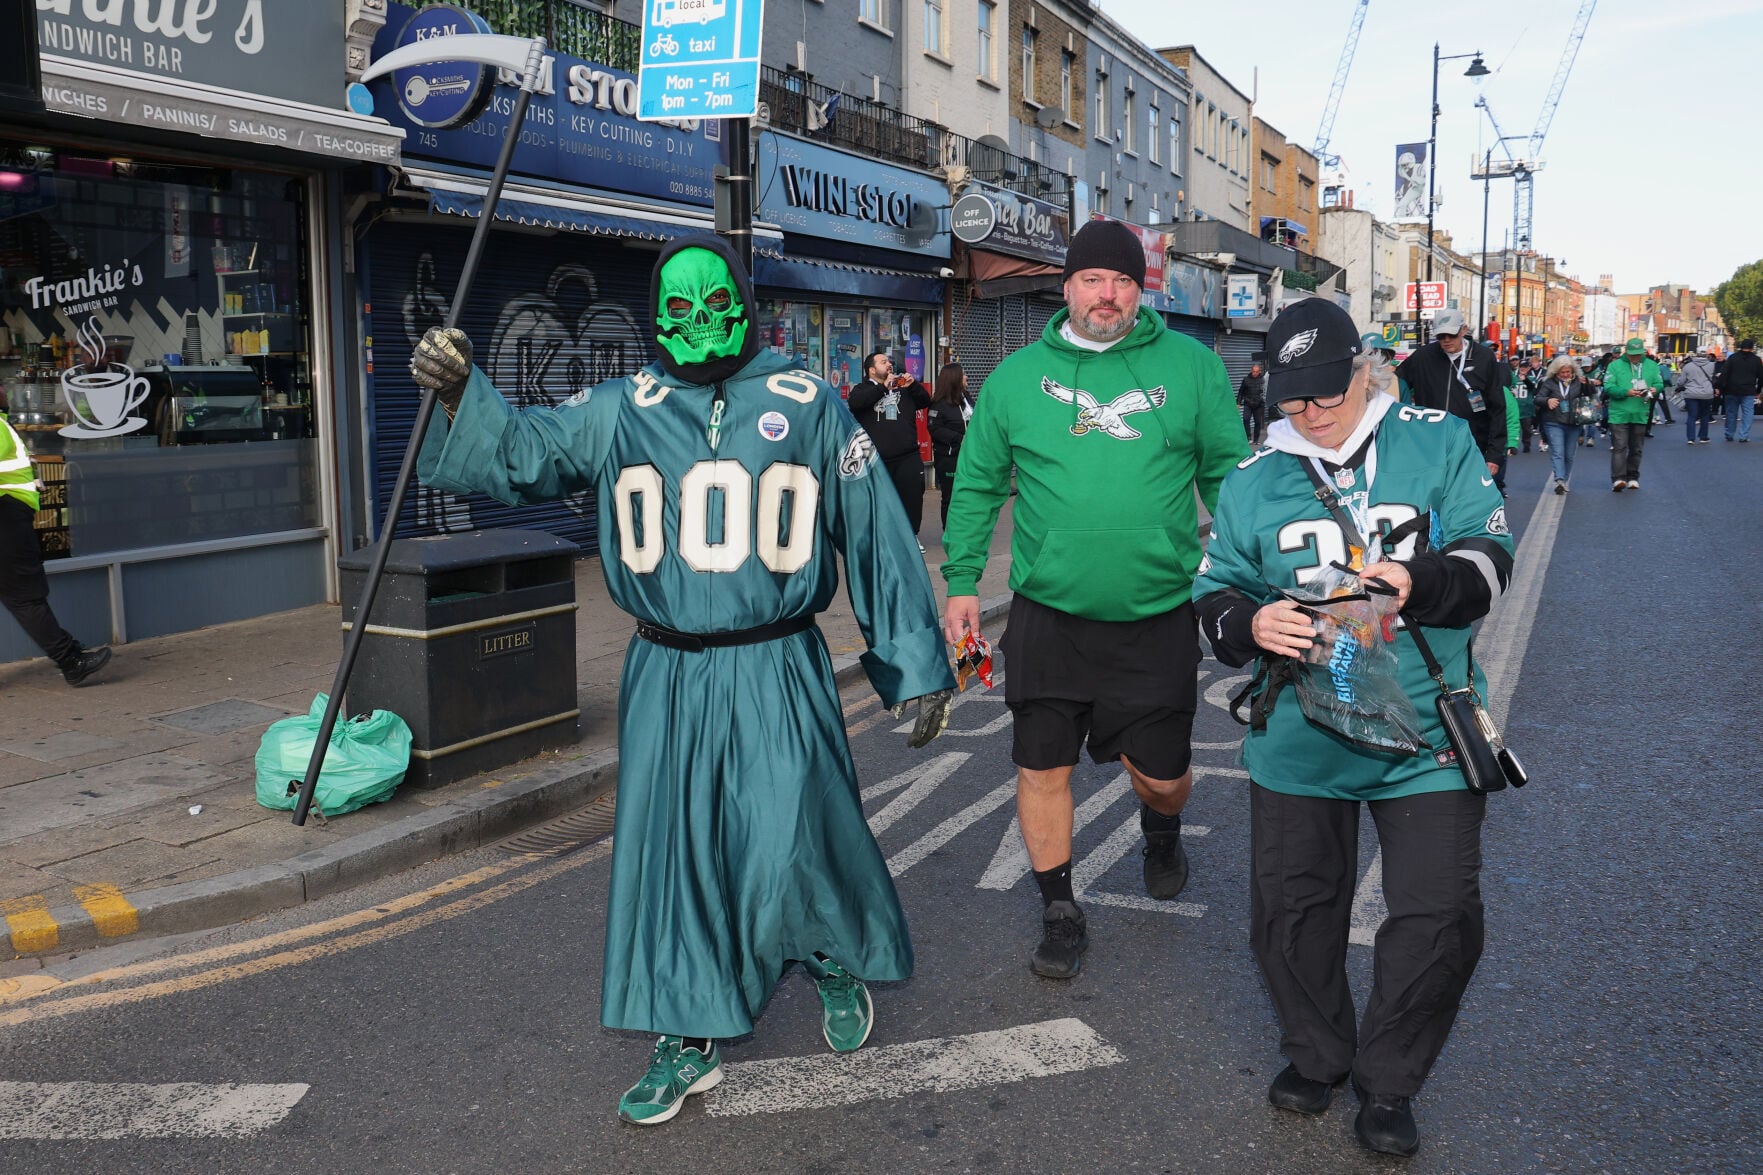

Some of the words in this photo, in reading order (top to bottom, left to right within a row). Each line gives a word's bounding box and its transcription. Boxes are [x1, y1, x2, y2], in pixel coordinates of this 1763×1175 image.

[689, 35, 716, 53] taxi
[143, 41, 183, 73] BAR
[665, 74, 694, 91] Mon
[711, 71, 731, 89] Fri
[703, 91, 733, 110] 7pm
[228, 118, 288, 142] SALADS
[313, 133, 396, 159] TEA-COFFEE
[418, 131, 439, 149] 745
[571, 113, 595, 134] KEY
[600, 121, 653, 148] CUTTING
[559, 137, 613, 161] PLUMBING
[669, 180, 684, 195] 020
[955, 217, 989, 229] LICENCE
[964, 208, 980, 218] OFF
[25, 258, 144, 310] Frankie's
[63, 302, 101, 316] SANDWICH
[104, 296, 119, 307] BAR
[483, 630, 531, 655] LITTER
